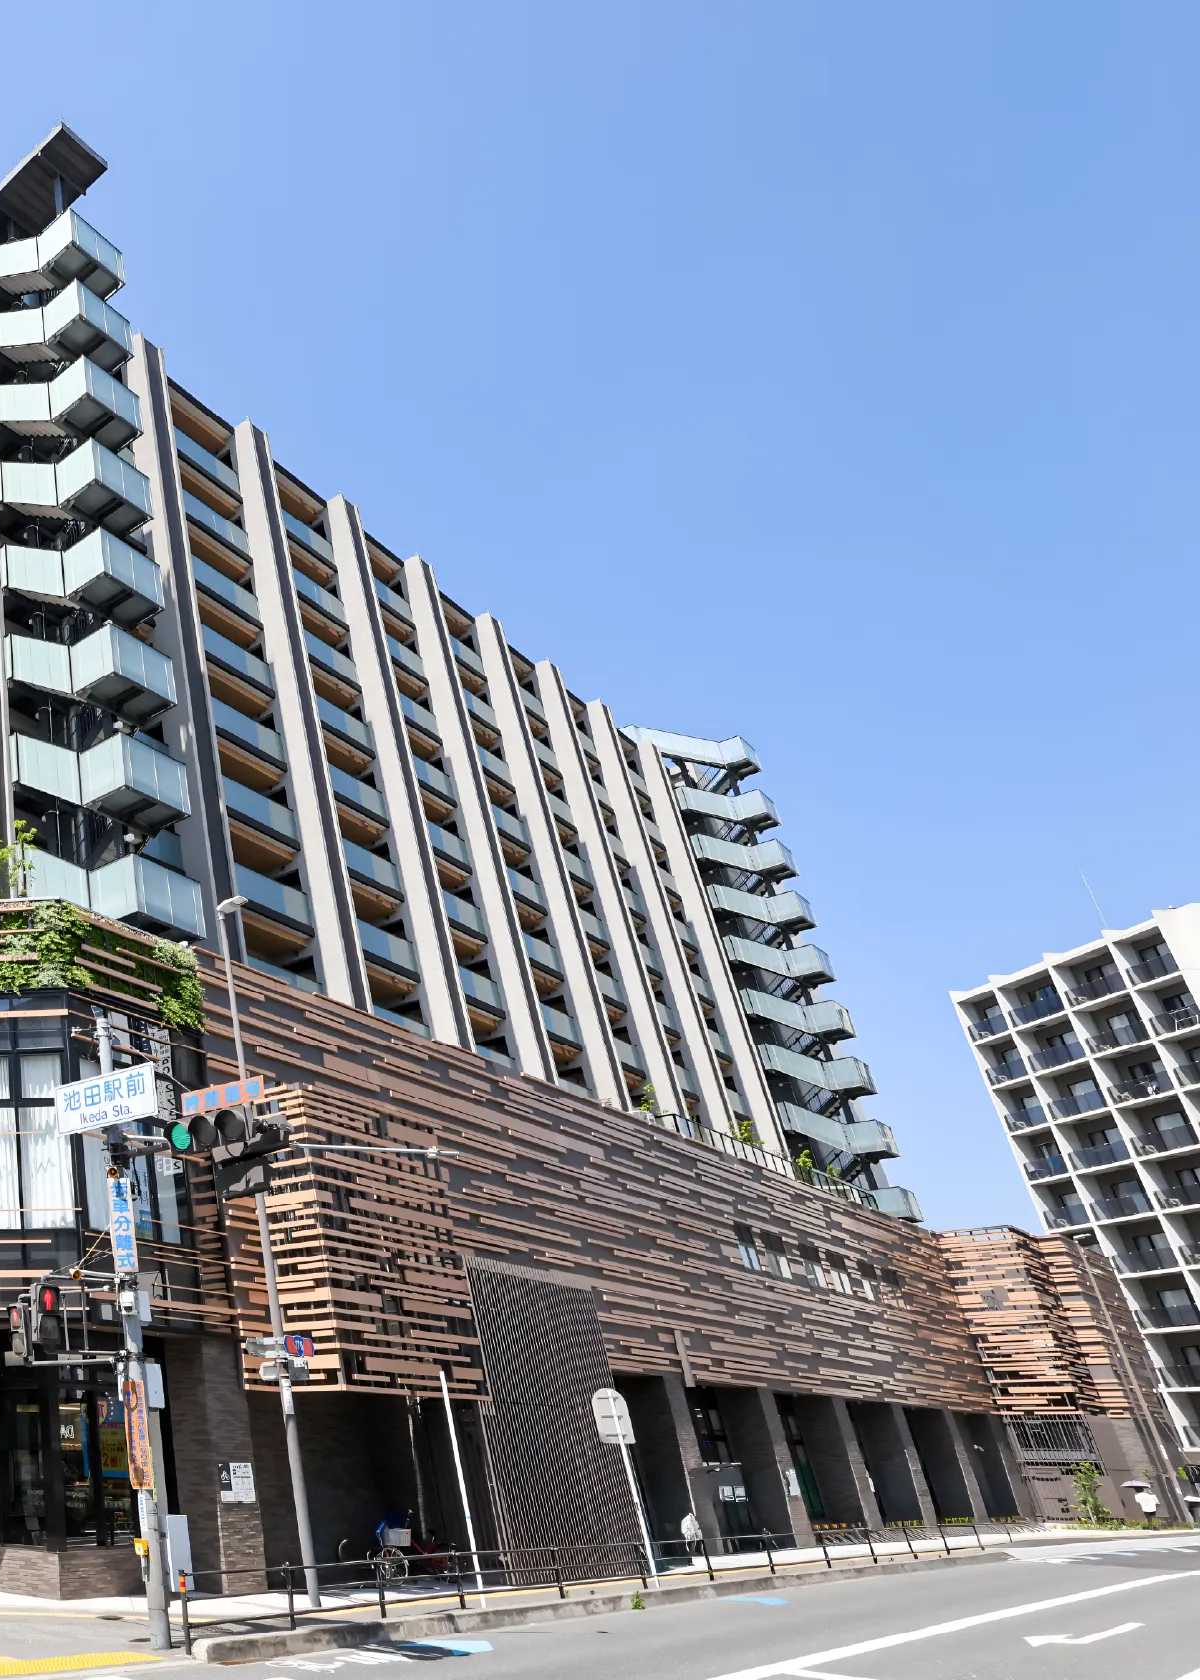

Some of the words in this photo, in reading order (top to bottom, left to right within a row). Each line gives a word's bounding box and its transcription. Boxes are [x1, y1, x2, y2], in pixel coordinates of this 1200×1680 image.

[63, 1071, 145, 1112] 池田駅前
[80, 1109, 108, 1124] Ikeda
[112, 1103, 133, 1118] Sta.
